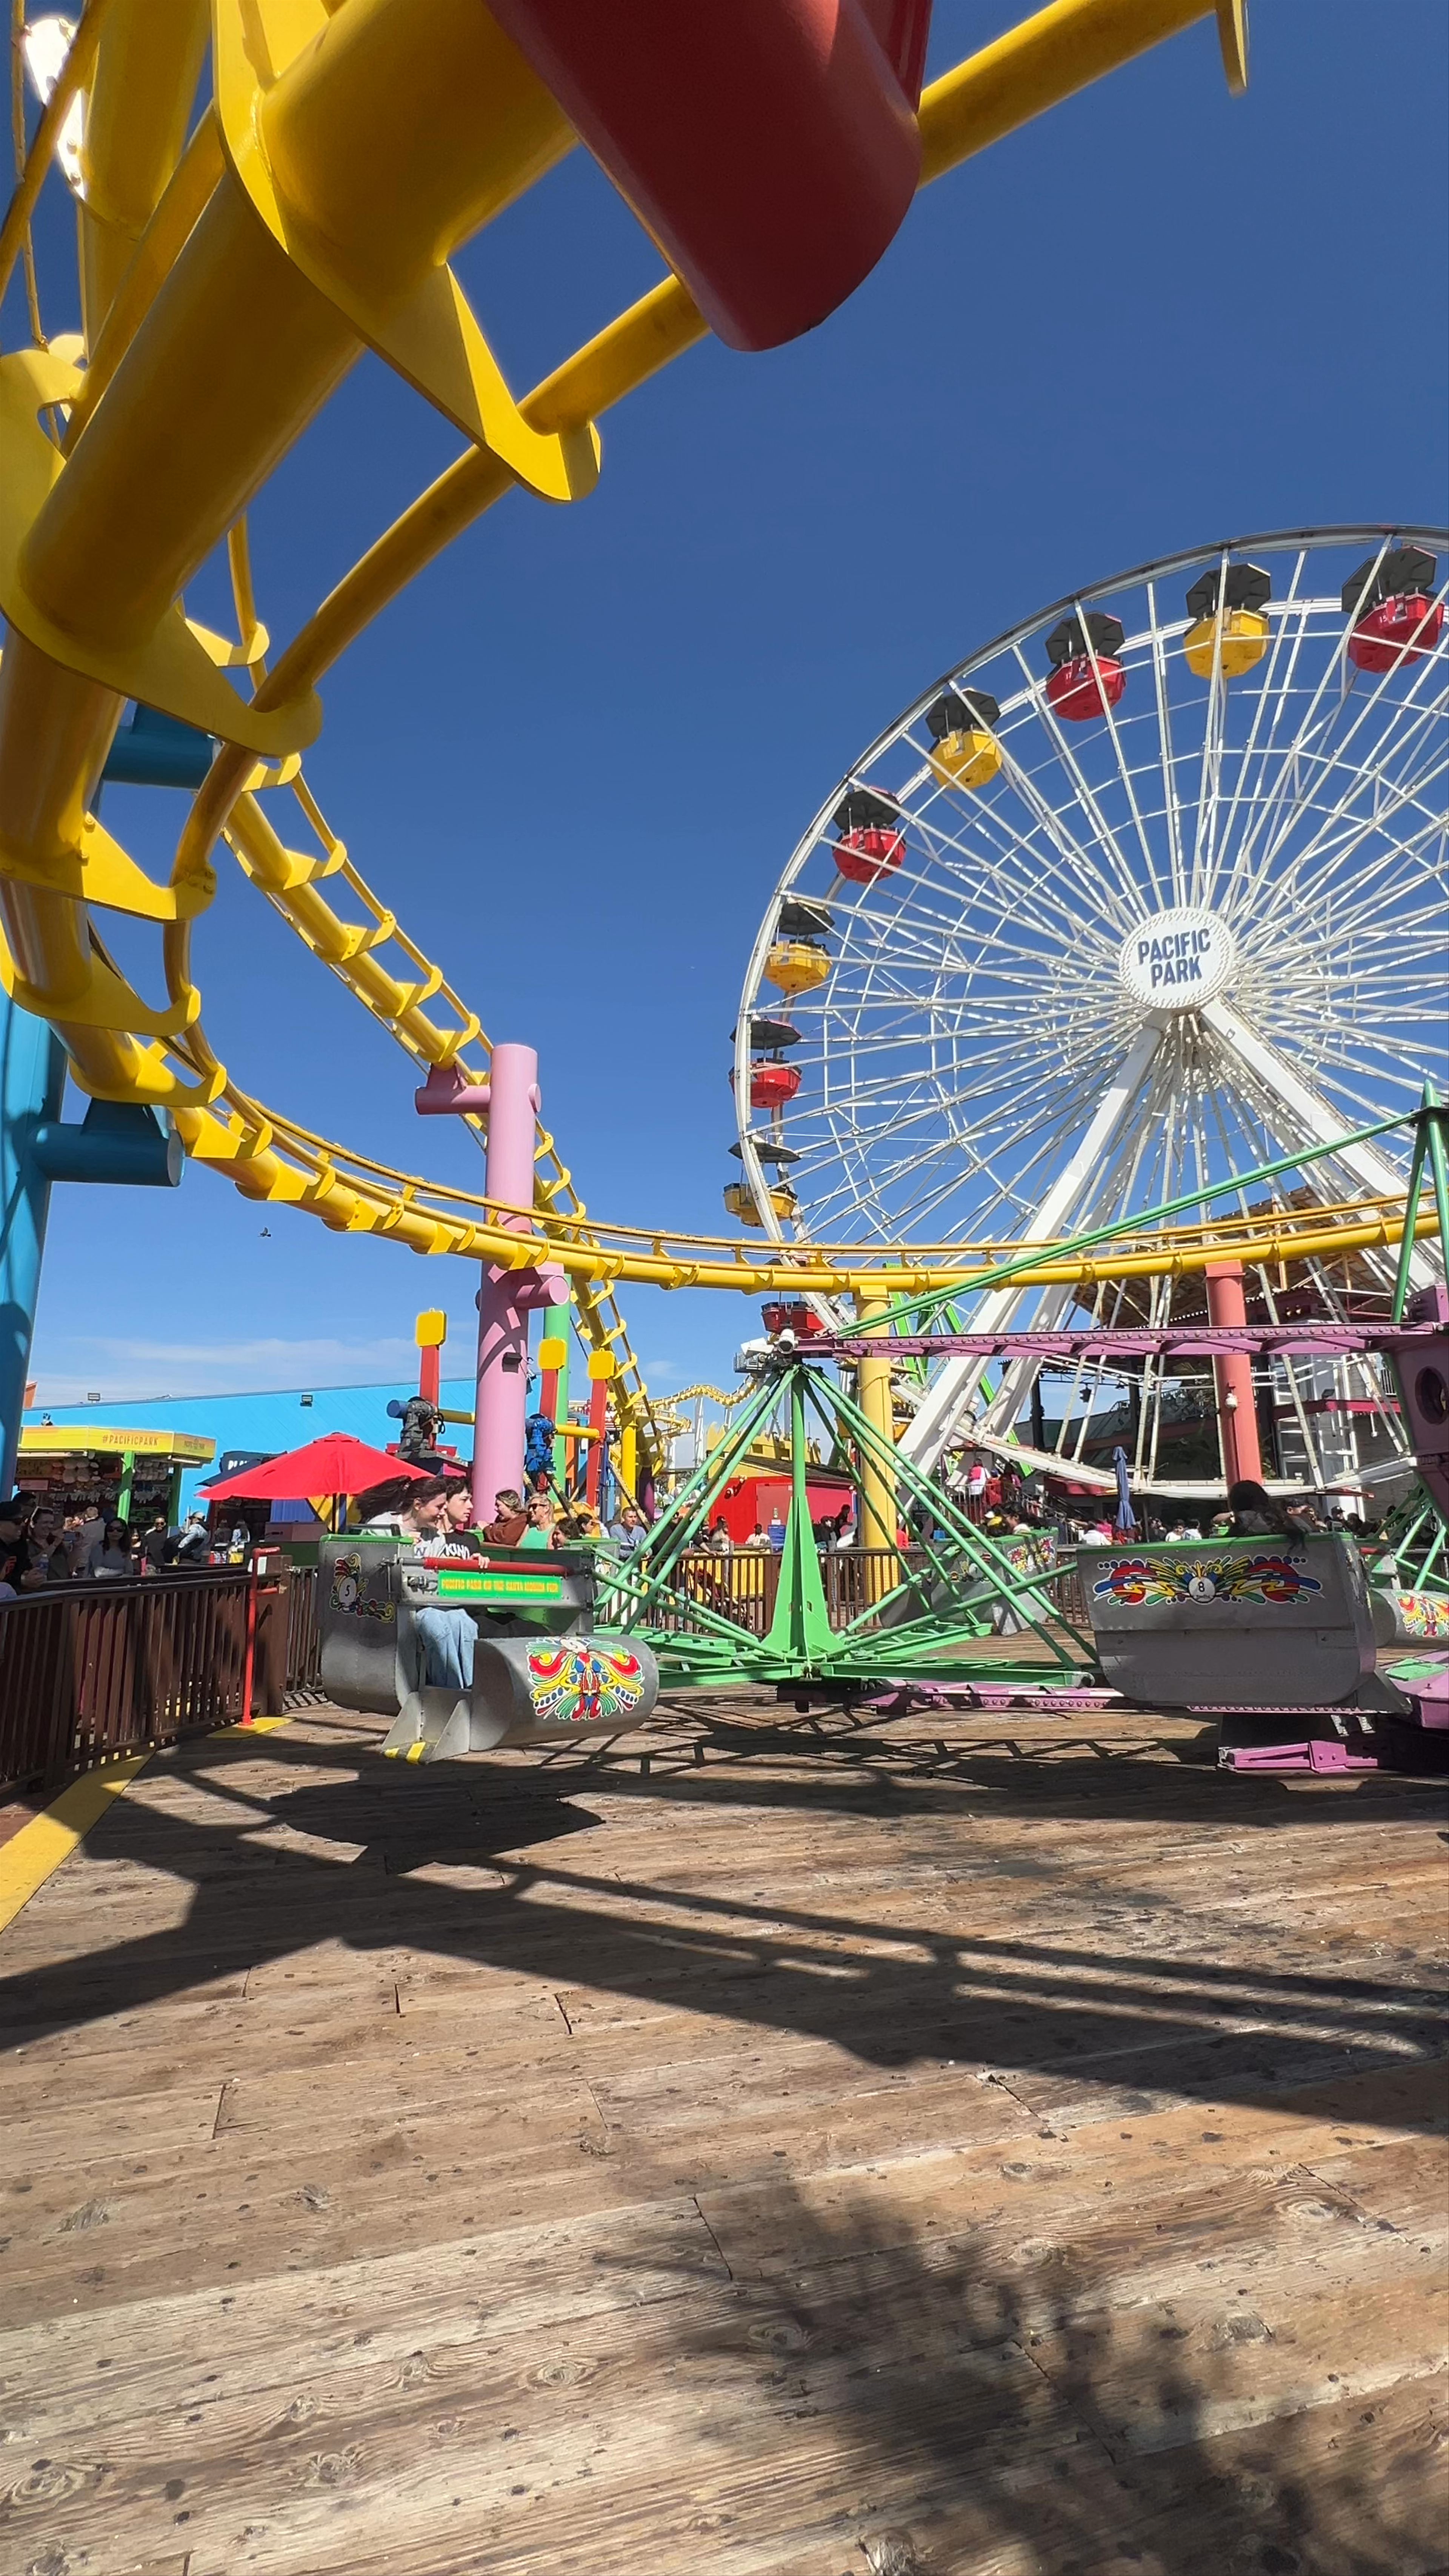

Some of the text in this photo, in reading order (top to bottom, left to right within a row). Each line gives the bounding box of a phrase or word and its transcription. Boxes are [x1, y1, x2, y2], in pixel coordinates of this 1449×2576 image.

[1137, 928, 1211, 965] PACIFIC
[1151, 955, 1202, 989] PARK
[102, 1435, 158, 1446] #PACIFICPARK
[345, 1585, 350, 1596] 5
[1198, 1581, 1205, 1592] 8
